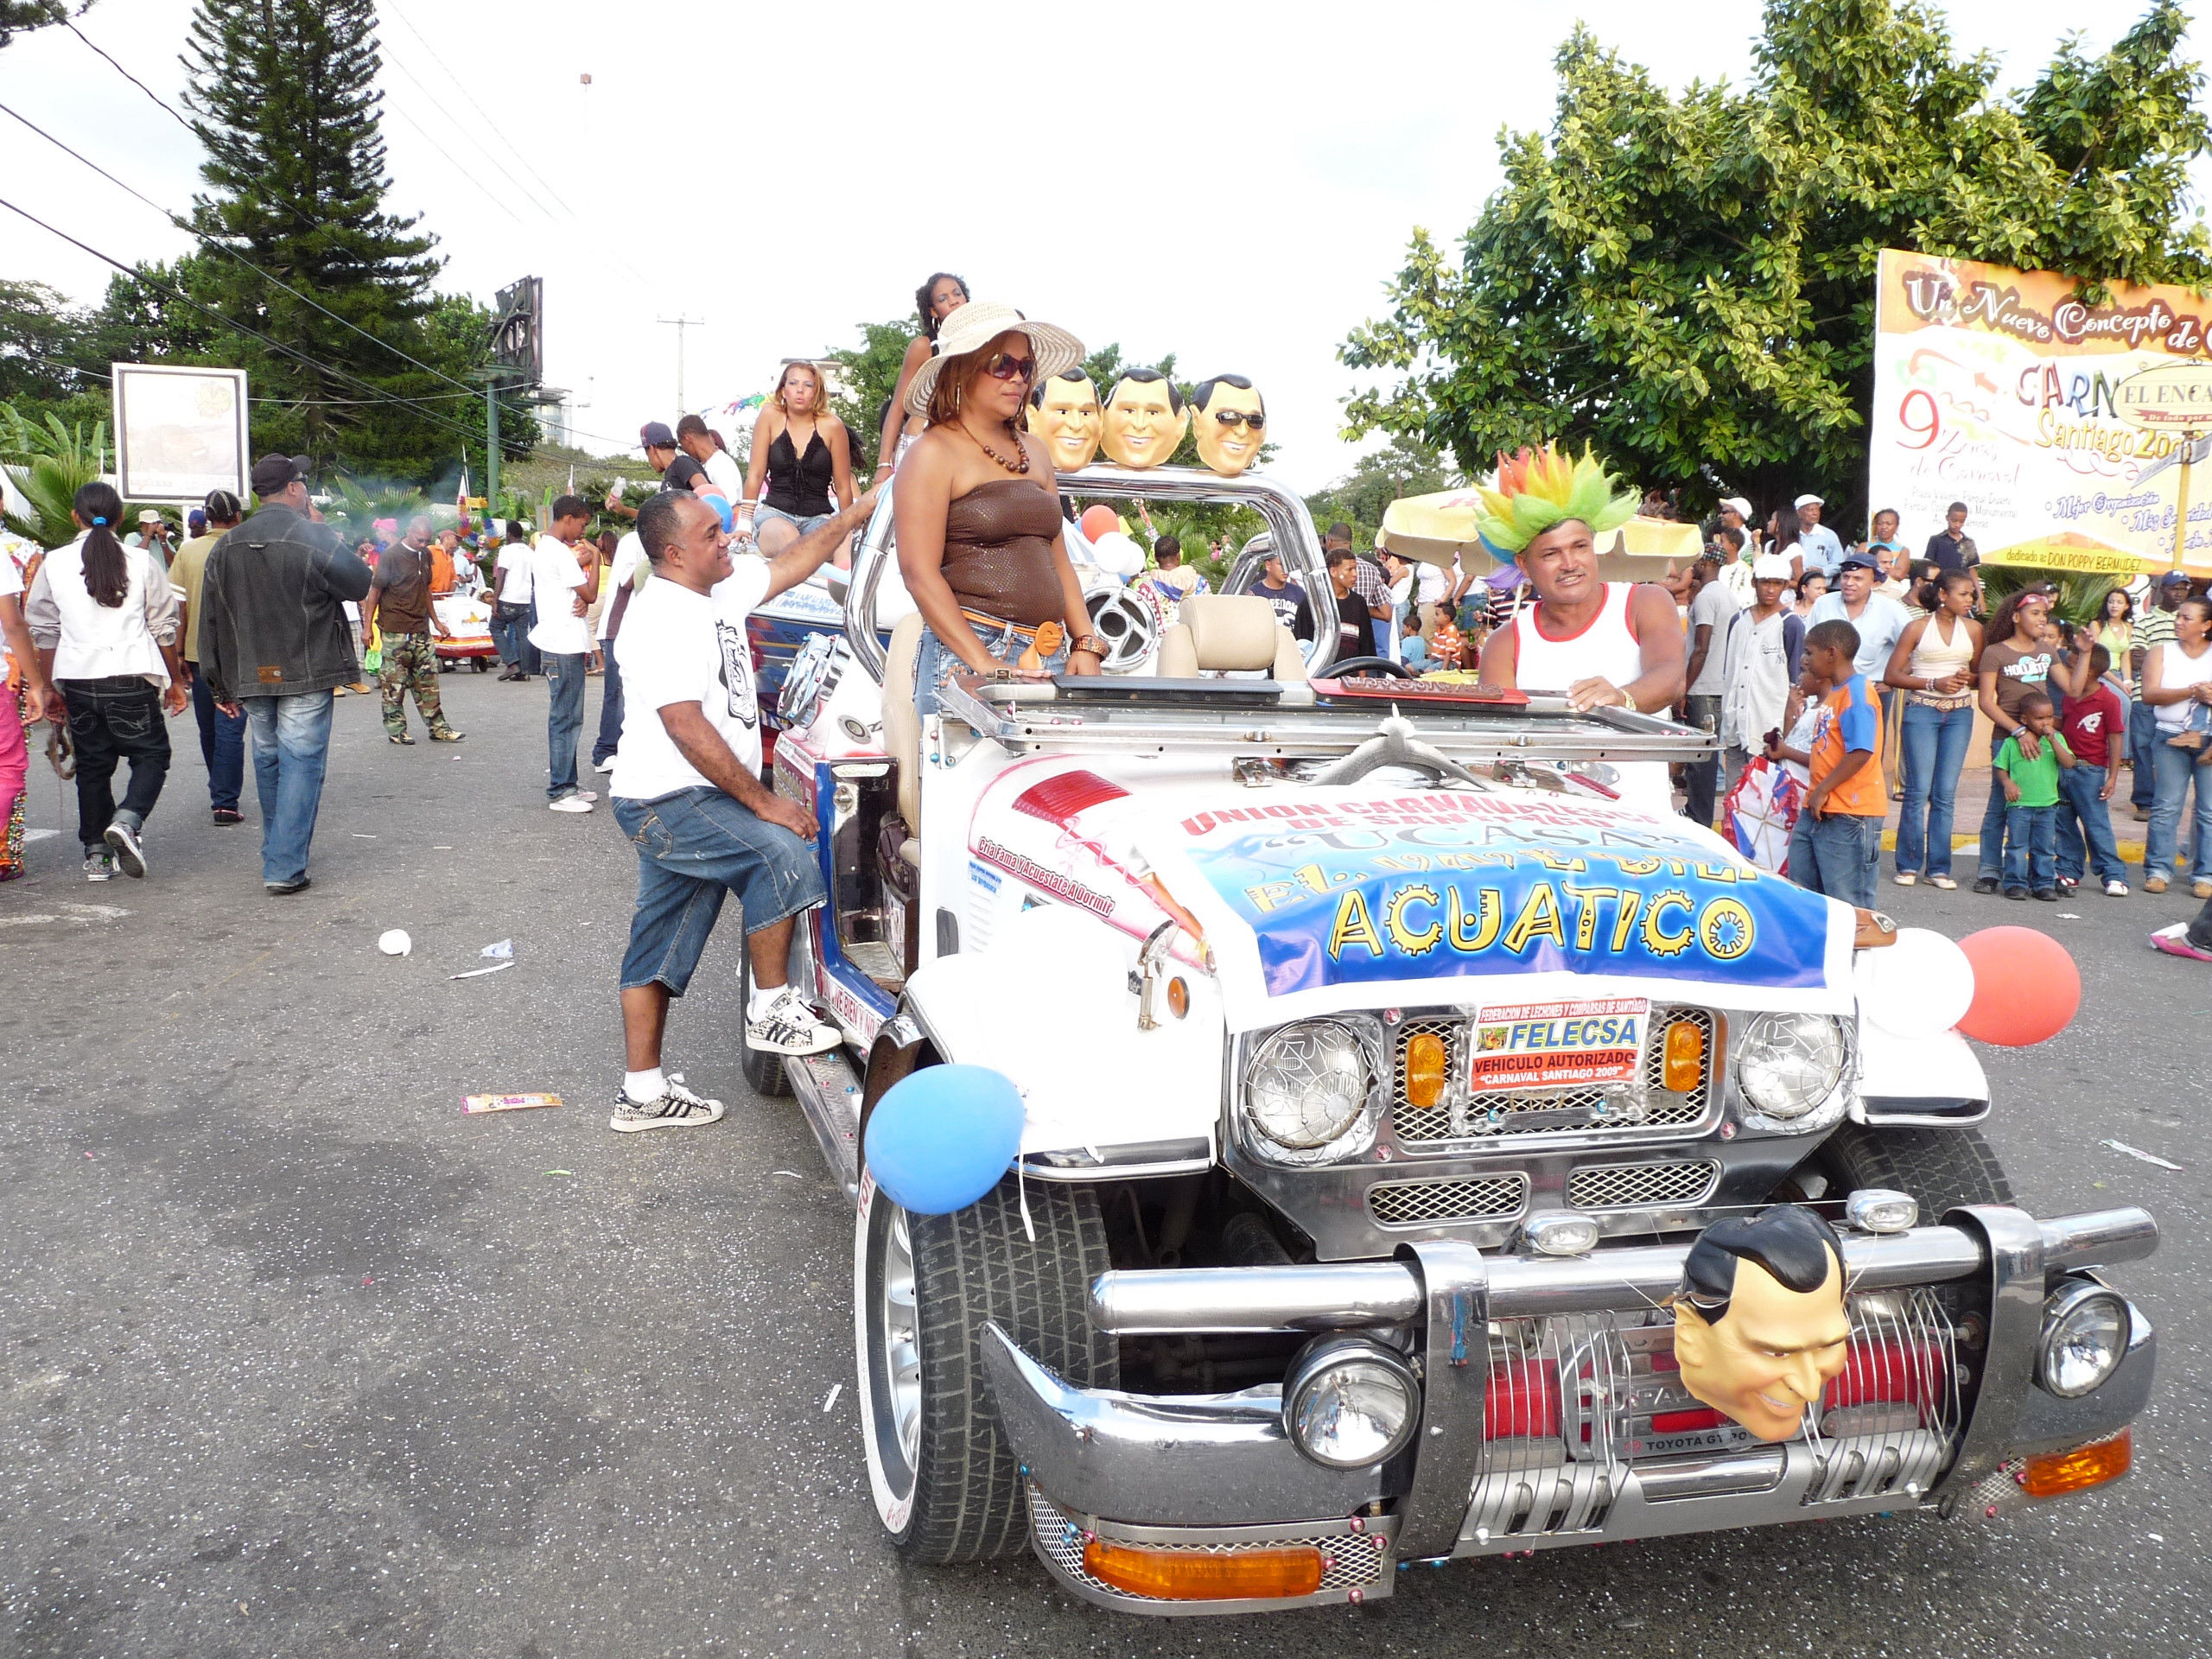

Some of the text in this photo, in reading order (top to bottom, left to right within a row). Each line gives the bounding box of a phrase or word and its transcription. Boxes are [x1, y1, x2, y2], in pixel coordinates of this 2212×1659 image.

[1906, 276, 1954, 315] Un
[1962, 286, 2050, 339] Nuevo
[2055, 301, 2171, 344] Concepto
[2167, 321, 2200, 348] de
[2016, 360, 2120, 418] CARN
[2125, 385, 2150, 404] EL
[1896, 389, 1940, 449] 9
[2035, 408, 2134, 462] Santiago
[2005, 549, 2037, 562] dedicado
[2047, 552, 2066, 567] DON
[2068, 554, 2095, 569] POPPY
[2095, 556, 2142, 572] BERMUDEZ
[1180, 804, 1331, 836] UNION
[1285, 817, 1355, 830] DE
[978, 836, 995, 859] Cria
[995, 845, 1018, 869] Fama
[1023, 858, 1070, 895] Acuestate
[1067, 881, 1077, 900] A
[1076, 884, 1116, 917] Dormir
[1328, 880, 1756, 962] ACUATICO
[1480, 1007, 1521, 1022] FEDERACION
[1521, 1006, 1530, 1019] DE
[1530, 1004, 1563, 1018] LECHONES
[1568, 1001, 1606, 1016] COMPARSAS
[1606, 1001, 1616, 1014] DE
[1615, 999, 1647, 1014] SANTIAGO
[1509, 1018, 1639, 1051] FELECSA
[1475, 1051, 1637, 1073] VEHICULO AUTORIZADO
[1541, 1069, 1593, 1081] SANTIAGO
[1646, 1434, 1702, 1451] TOYOTA
